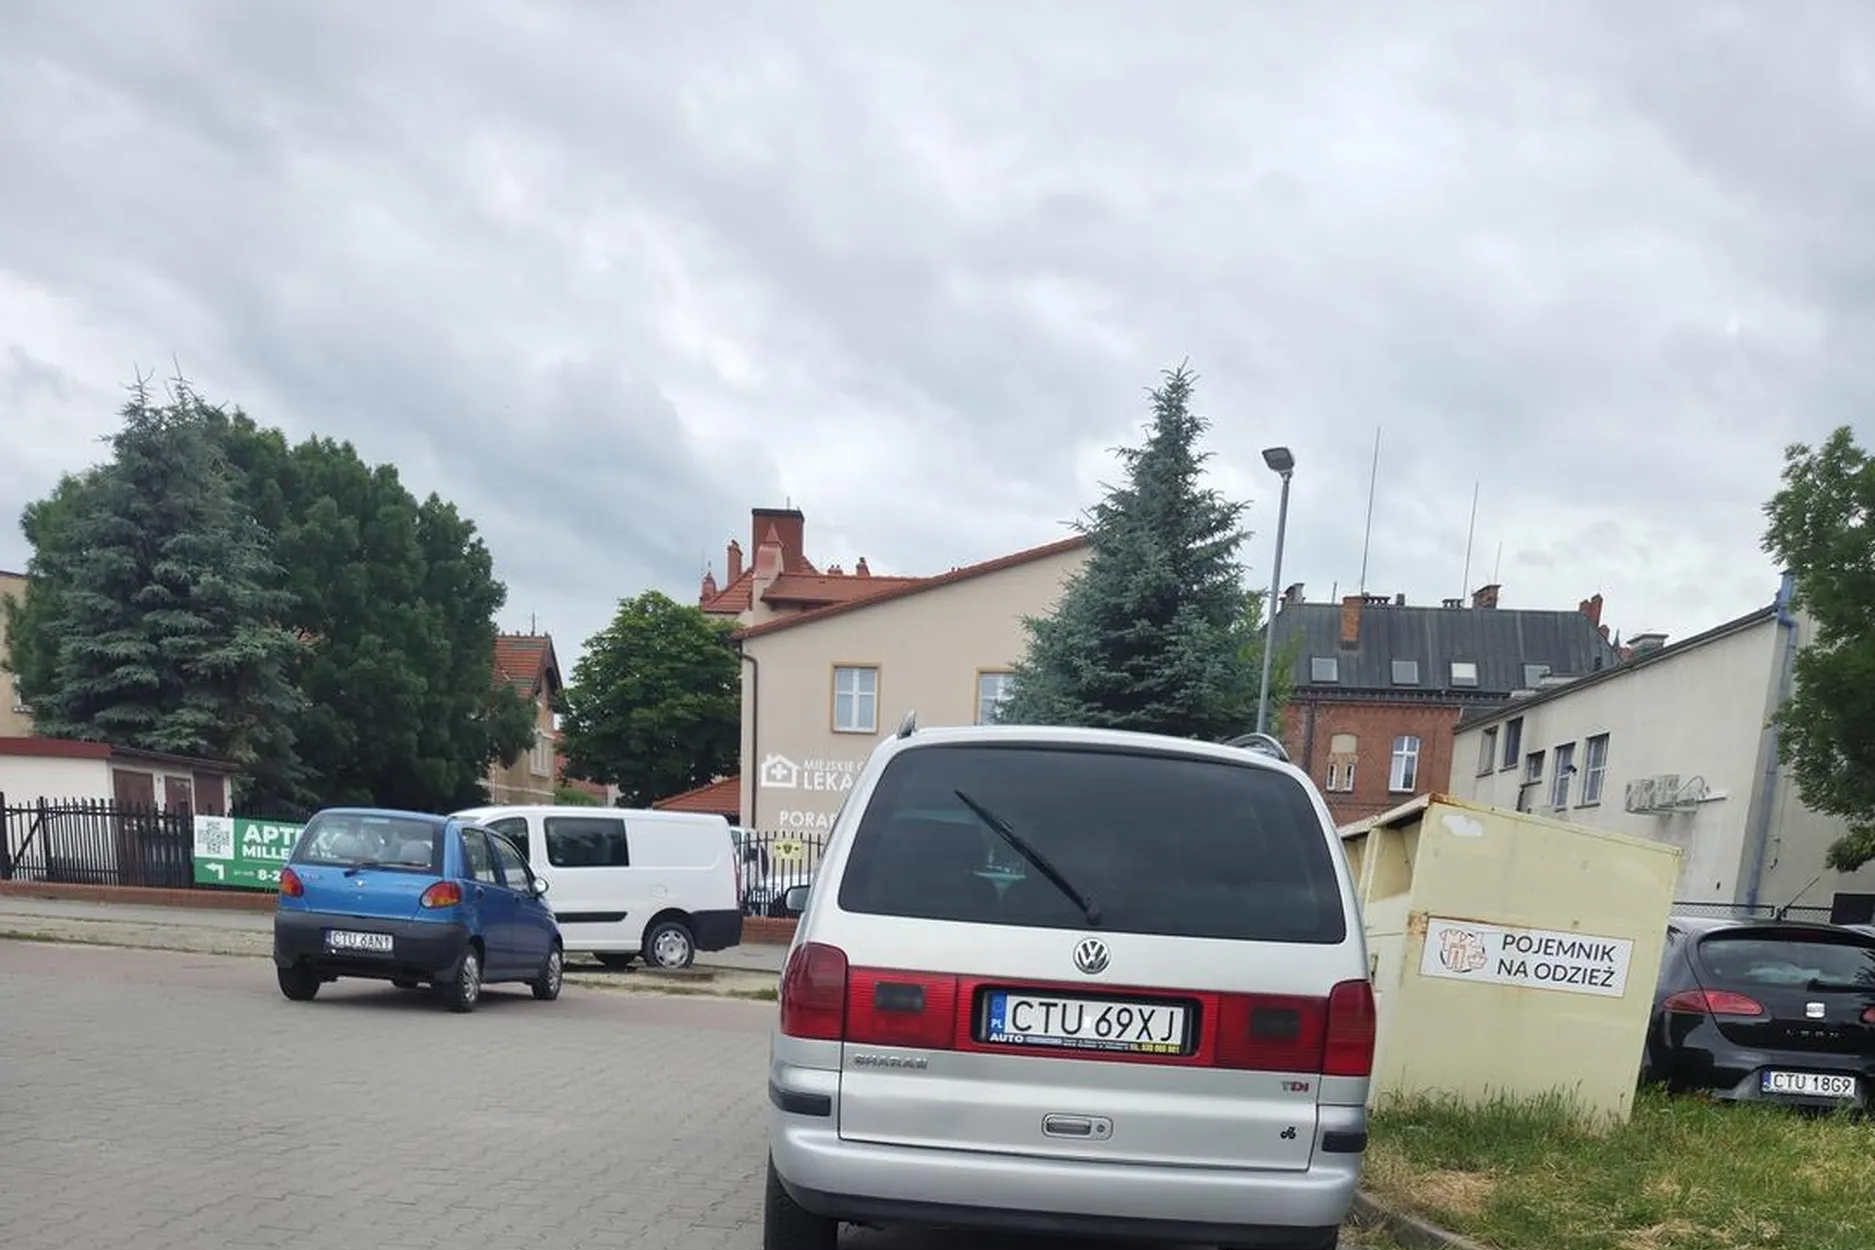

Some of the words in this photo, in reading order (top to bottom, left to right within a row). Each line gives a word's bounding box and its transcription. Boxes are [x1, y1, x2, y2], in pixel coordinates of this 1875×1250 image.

[1502, 934, 1616, 963] POJEMNIK
[1497, 958, 1529, 978] NA
[1533, 962, 1615, 987] ODZIEŻ
[1011, 1001, 1083, 1035] CTU
[1095, 1006, 1174, 1042] 69XJ
[989, 1032, 1024, 1043] AUTO
[1281, 1081, 1310, 1093] TDI
[1773, 1073, 1807, 1090] CTU
[1813, 1076, 1852, 1093] 18G9
